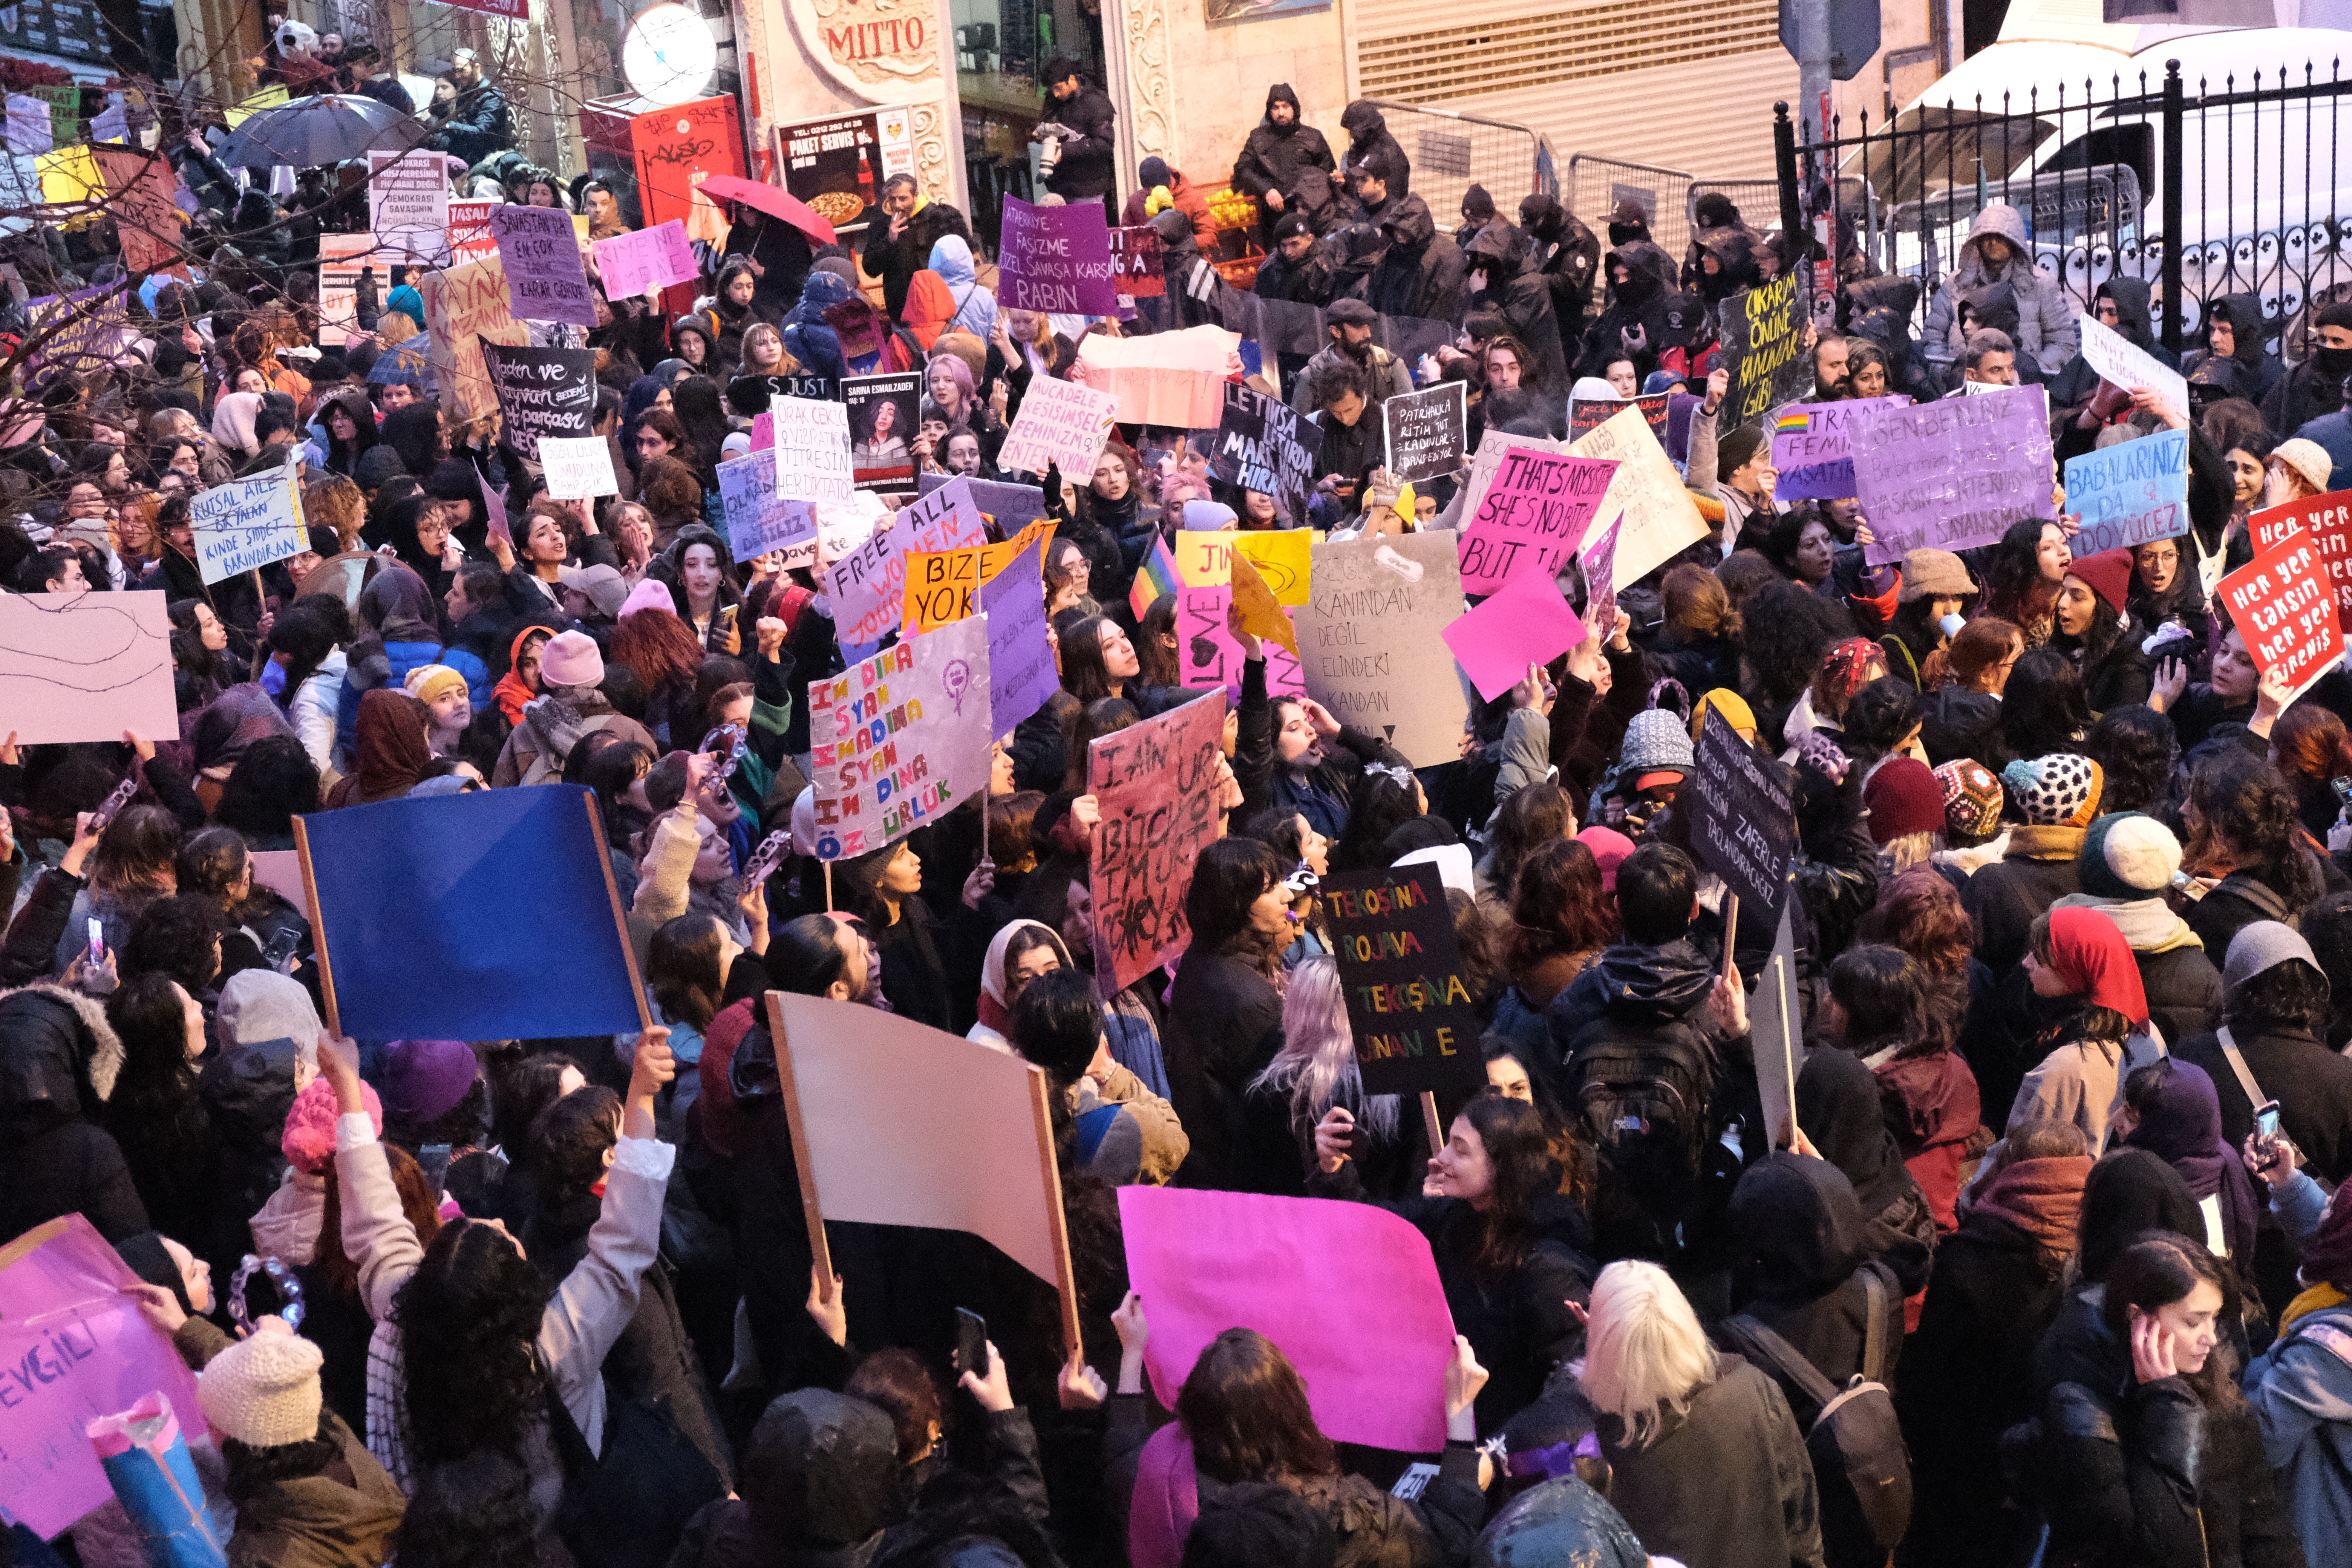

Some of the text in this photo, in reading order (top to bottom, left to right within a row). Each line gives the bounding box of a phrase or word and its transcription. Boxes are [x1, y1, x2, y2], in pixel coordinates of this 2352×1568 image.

[828, 16, 924, 60] MITTO
[789, 136, 819, 157] PAKET
[1016, 231, 1071, 257] FAŞİZME
[1000, 245, 1024, 275] ÖZEL
[1026, 255, 1072, 281] SAVAŞA
[1016, 279, 1078, 311] RABIN
[1750, 298, 1795, 349] ÖNÜNE
[538, 364, 568, 381] ve
[787, 377, 828, 397] JUST
[848, 386, 870, 397] SARINA
[1031, 380, 1099, 409] MÜCADELE
[778, 401, 810, 424] ORAK
[1014, 420, 1082, 447] FEMİNİZM
[1400, 418, 1449, 437] RİTİM TUT
[545, 440, 608, 459] GÜZEL ÜLKEM
[1404, 433, 1450, 452] KADINLAR
[554, 460, 608, 478] UMUDUNA
[782, 445, 848, 473] TİTRESİN
[2069, 437, 2185, 499] BABALARINIZ
[778, 472, 803, 496] HER
[1479, 493, 1537, 527] SHE'S
[1533, 500, 1564, 534] NO
[2098, 491, 2125, 521] DA
[835, 533, 890, 599] FREE
[910, 491, 956, 532] ALL
[1601, 529, 1612, 546] ASLA
[223, 536, 296, 576] BARINDIRAN
[1460, 537, 1527, 579] BUT
[915, 586, 977, 625] YOK
[1314, 587, 1412, 619] KANINDAN
[1318, 621, 1367, 647] DEĞİL
[1323, 652, 1390, 677] ELİNDEKİ
[1327, 691, 1389, 712] KANDAN
[817, 779, 952, 859] ÖZGÜRLÜK
[1735, 813, 1780, 881] ZAFERLE
[1343, 931, 1423, 962] ROJAVA
[1436, 1027, 1457, 1056] E
